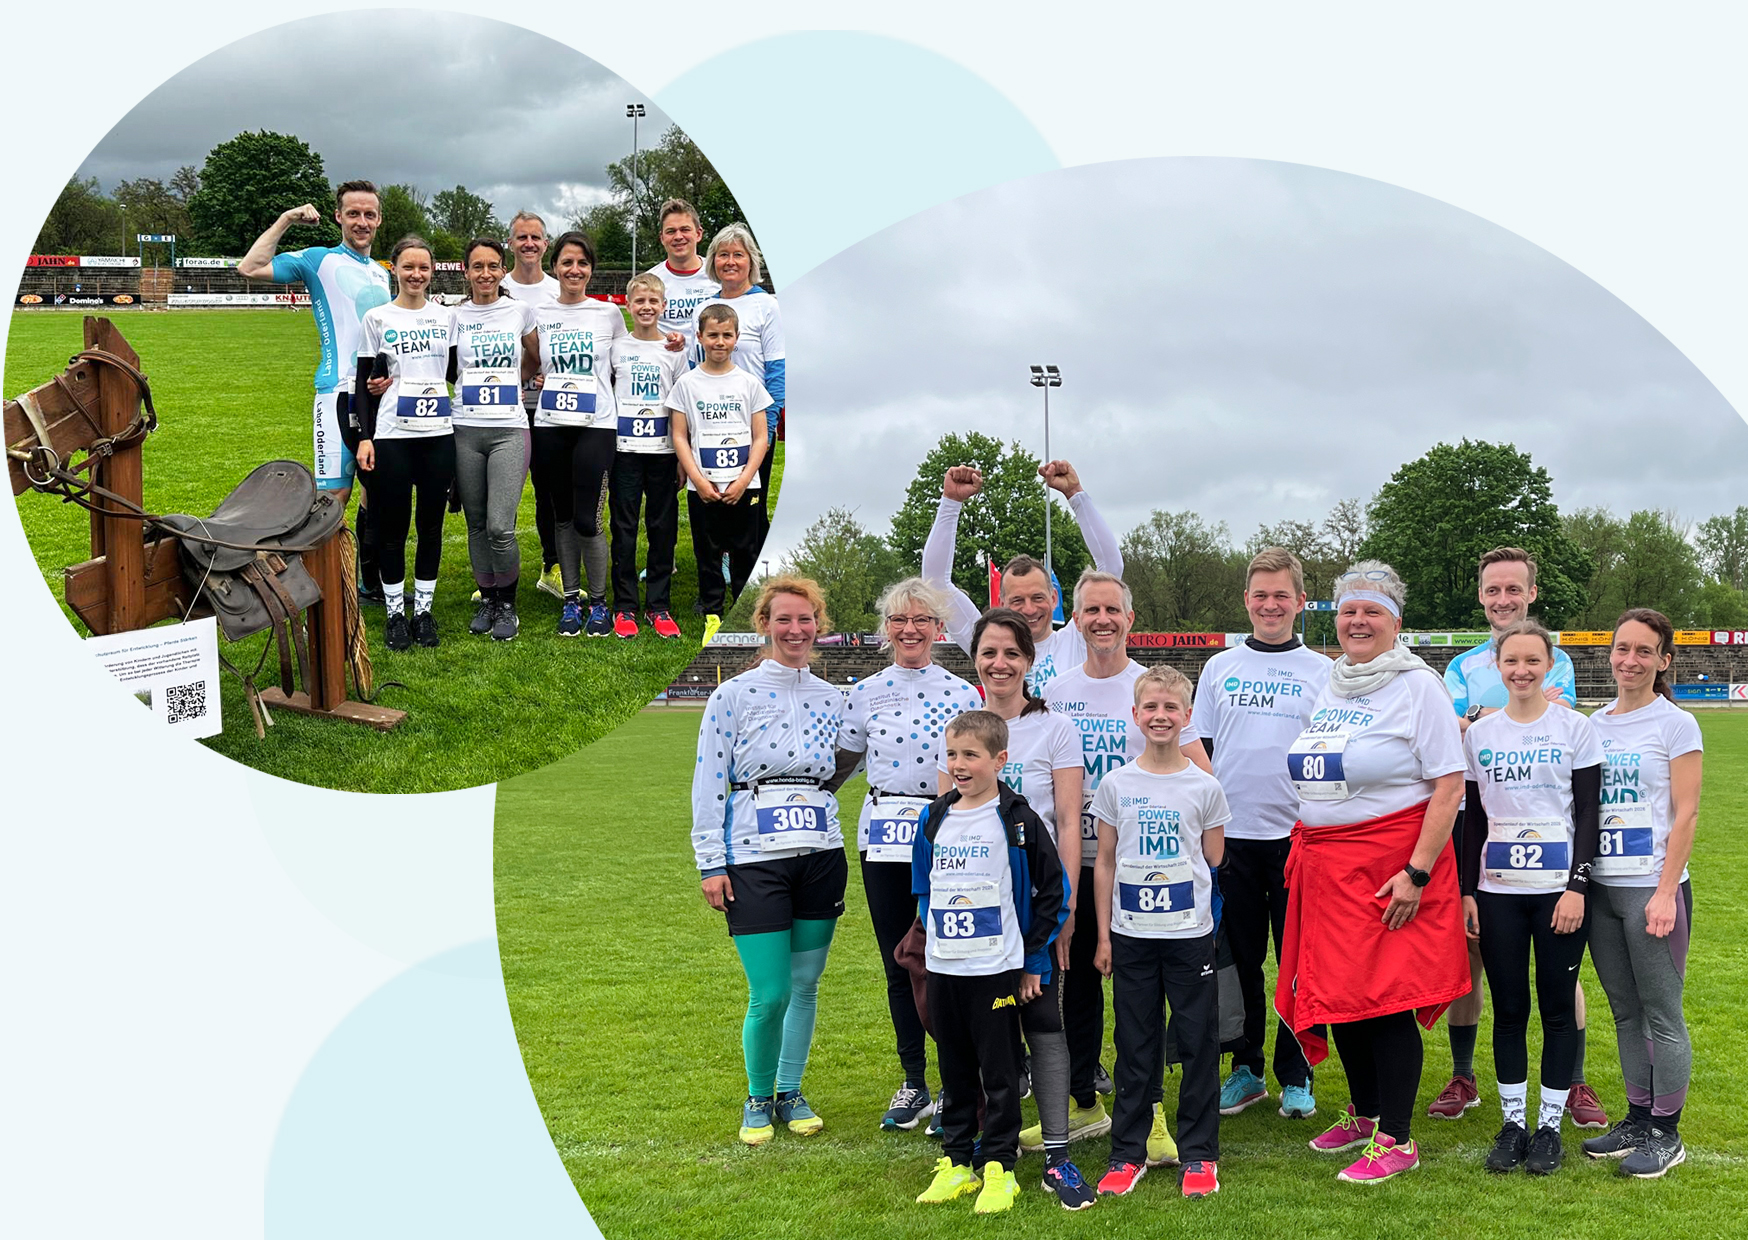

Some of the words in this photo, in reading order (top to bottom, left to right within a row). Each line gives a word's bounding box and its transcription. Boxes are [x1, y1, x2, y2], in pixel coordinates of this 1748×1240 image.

[436, 263, 462, 271] REWE
[316, 298, 330, 344] Oderland
[400, 328, 447, 341] POWER
[472, 332, 514, 344] POWER
[550, 332, 593, 342] POWER
[392, 340, 430, 355] TEAM
[470, 342, 514, 358] TEAM
[549, 341, 594, 354] TEAM
[322, 349, 332, 376] Labor
[631, 372, 660, 382] TEAM
[478, 387, 500, 404] 81
[632, 382, 660, 396] IMD
[416, 399, 438, 416] 82
[556, 392, 578, 411] 85
[706, 402, 741, 411] POWER
[701, 412, 728, 420] TEAM
[632, 419, 656, 436] 84
[316, 430, 326, 475] Oderland
[716, 449, 738, 467] 83
[1128, 635, 1167, 646] KTRO
[1242, 681, 1302, 697] POWER
[1229, 694, 1274, 708] TEAM
[1082, 734, 1126, 753] EAM
[1495, 749, 1562, 766] POWER
[1303, 756, 1325, 779] 80
[1485, 766, 1531, 783] TEAM
[1602, 769, 1639, 786] EAM
[772, 807, 817, 830] 309
[1138, 810, 1180, 821] POWER
[1138, 821, 1179, 834] TEAM
[1600, 831, 1623, 855] 81
[942, 846, 989, 858] POWER
[1510, 845, 1542, 868] 82
[1138, 887, 1172, 911] 84
[943, 912, 975, 937] 83
